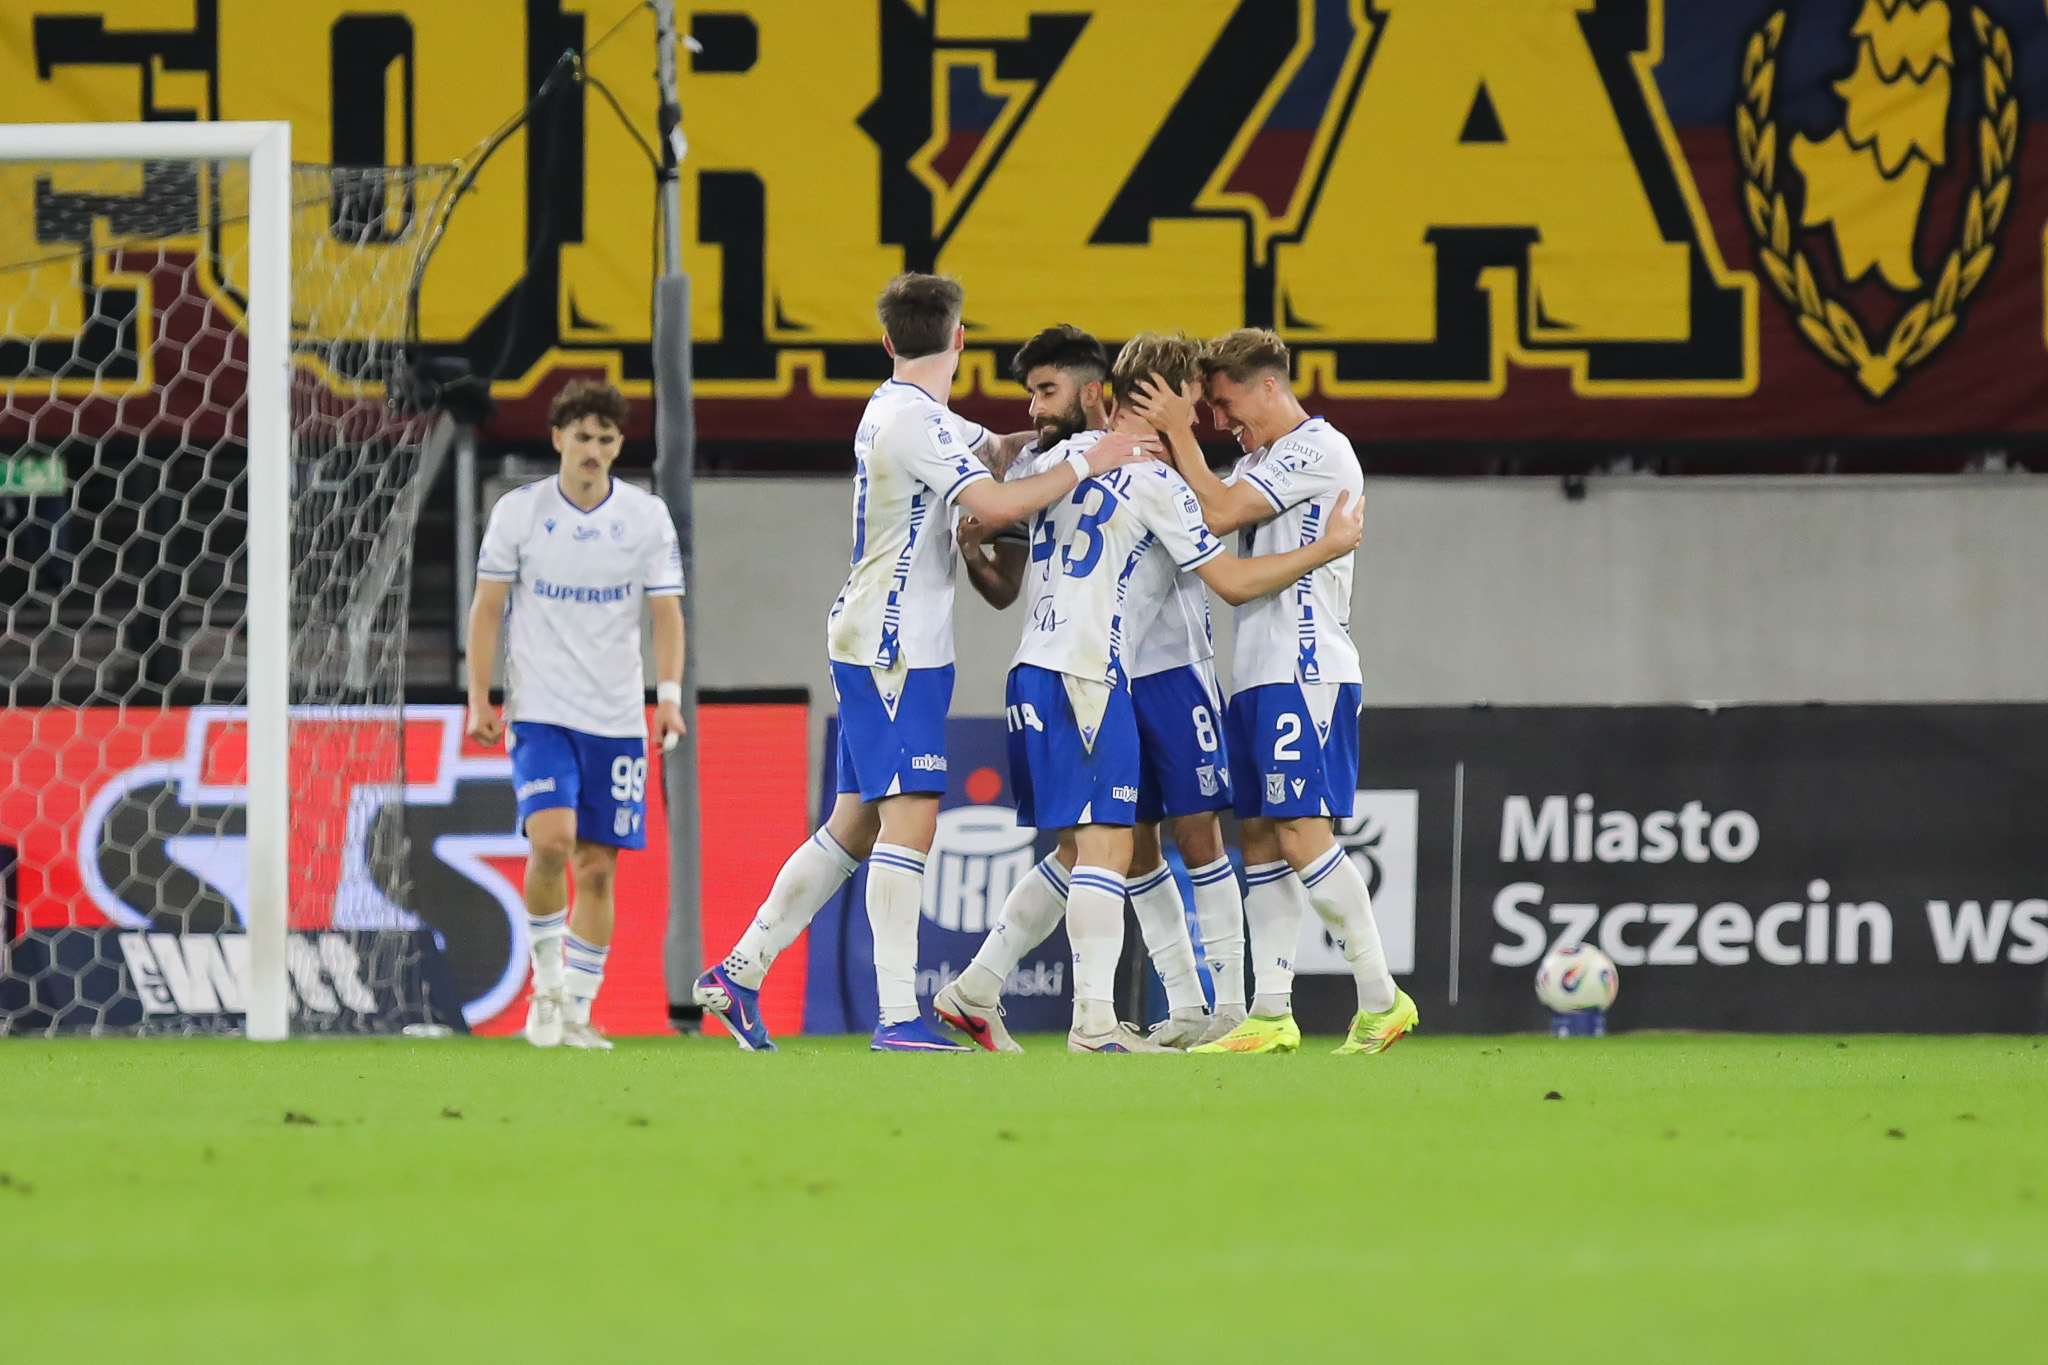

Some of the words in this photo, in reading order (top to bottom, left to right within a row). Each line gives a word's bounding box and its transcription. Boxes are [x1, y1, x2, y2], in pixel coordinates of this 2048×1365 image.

[0, 0, 1758, 398] FORZA
[1283, 440, 1324, 464] Ebury
[534, 579, 632, 604] SUPERBET
[1192, 705, 1218, 752] 8
[1274, 712, 1302, 761] 2
[611, 755, 646, 803] 99
[1499, 793, 1760, 863] Miasto
[1491, 878, 1893, 967] Szczecin
[1000, 960, 1064, 997] lski
